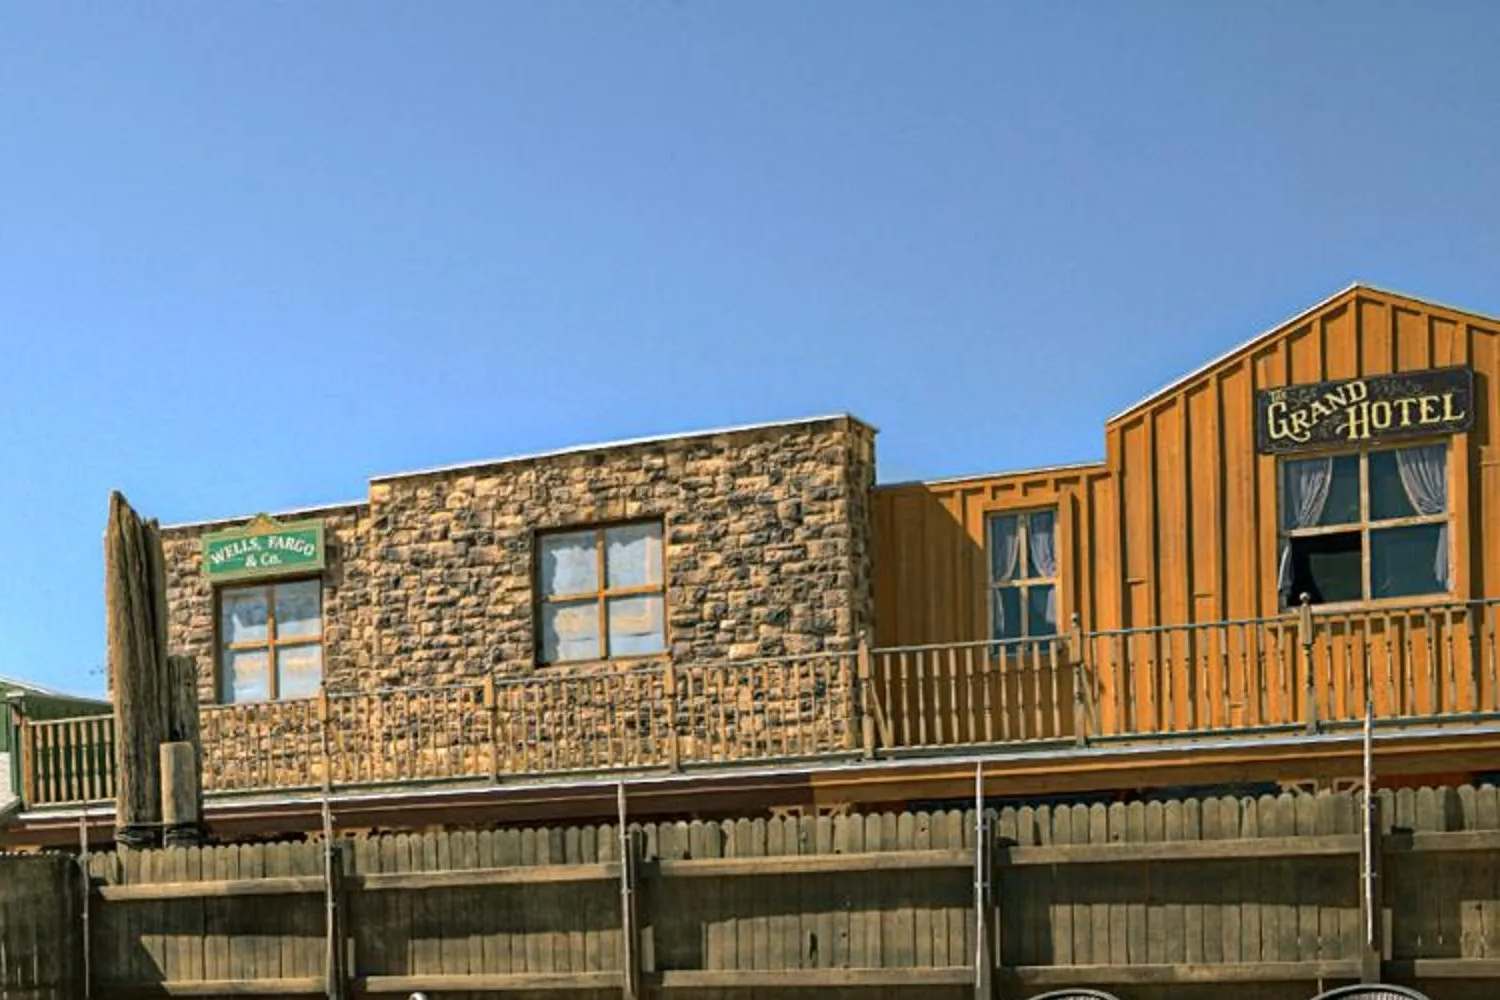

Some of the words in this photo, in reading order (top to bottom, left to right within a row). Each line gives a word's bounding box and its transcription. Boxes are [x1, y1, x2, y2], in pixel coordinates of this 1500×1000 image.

[1267, 381, 1367, 442] GRAND
[1335, 393, 1465, 439] HOTEL
[245, 553, 258, 567] &
[268, 535, 315, 557] FARGO
